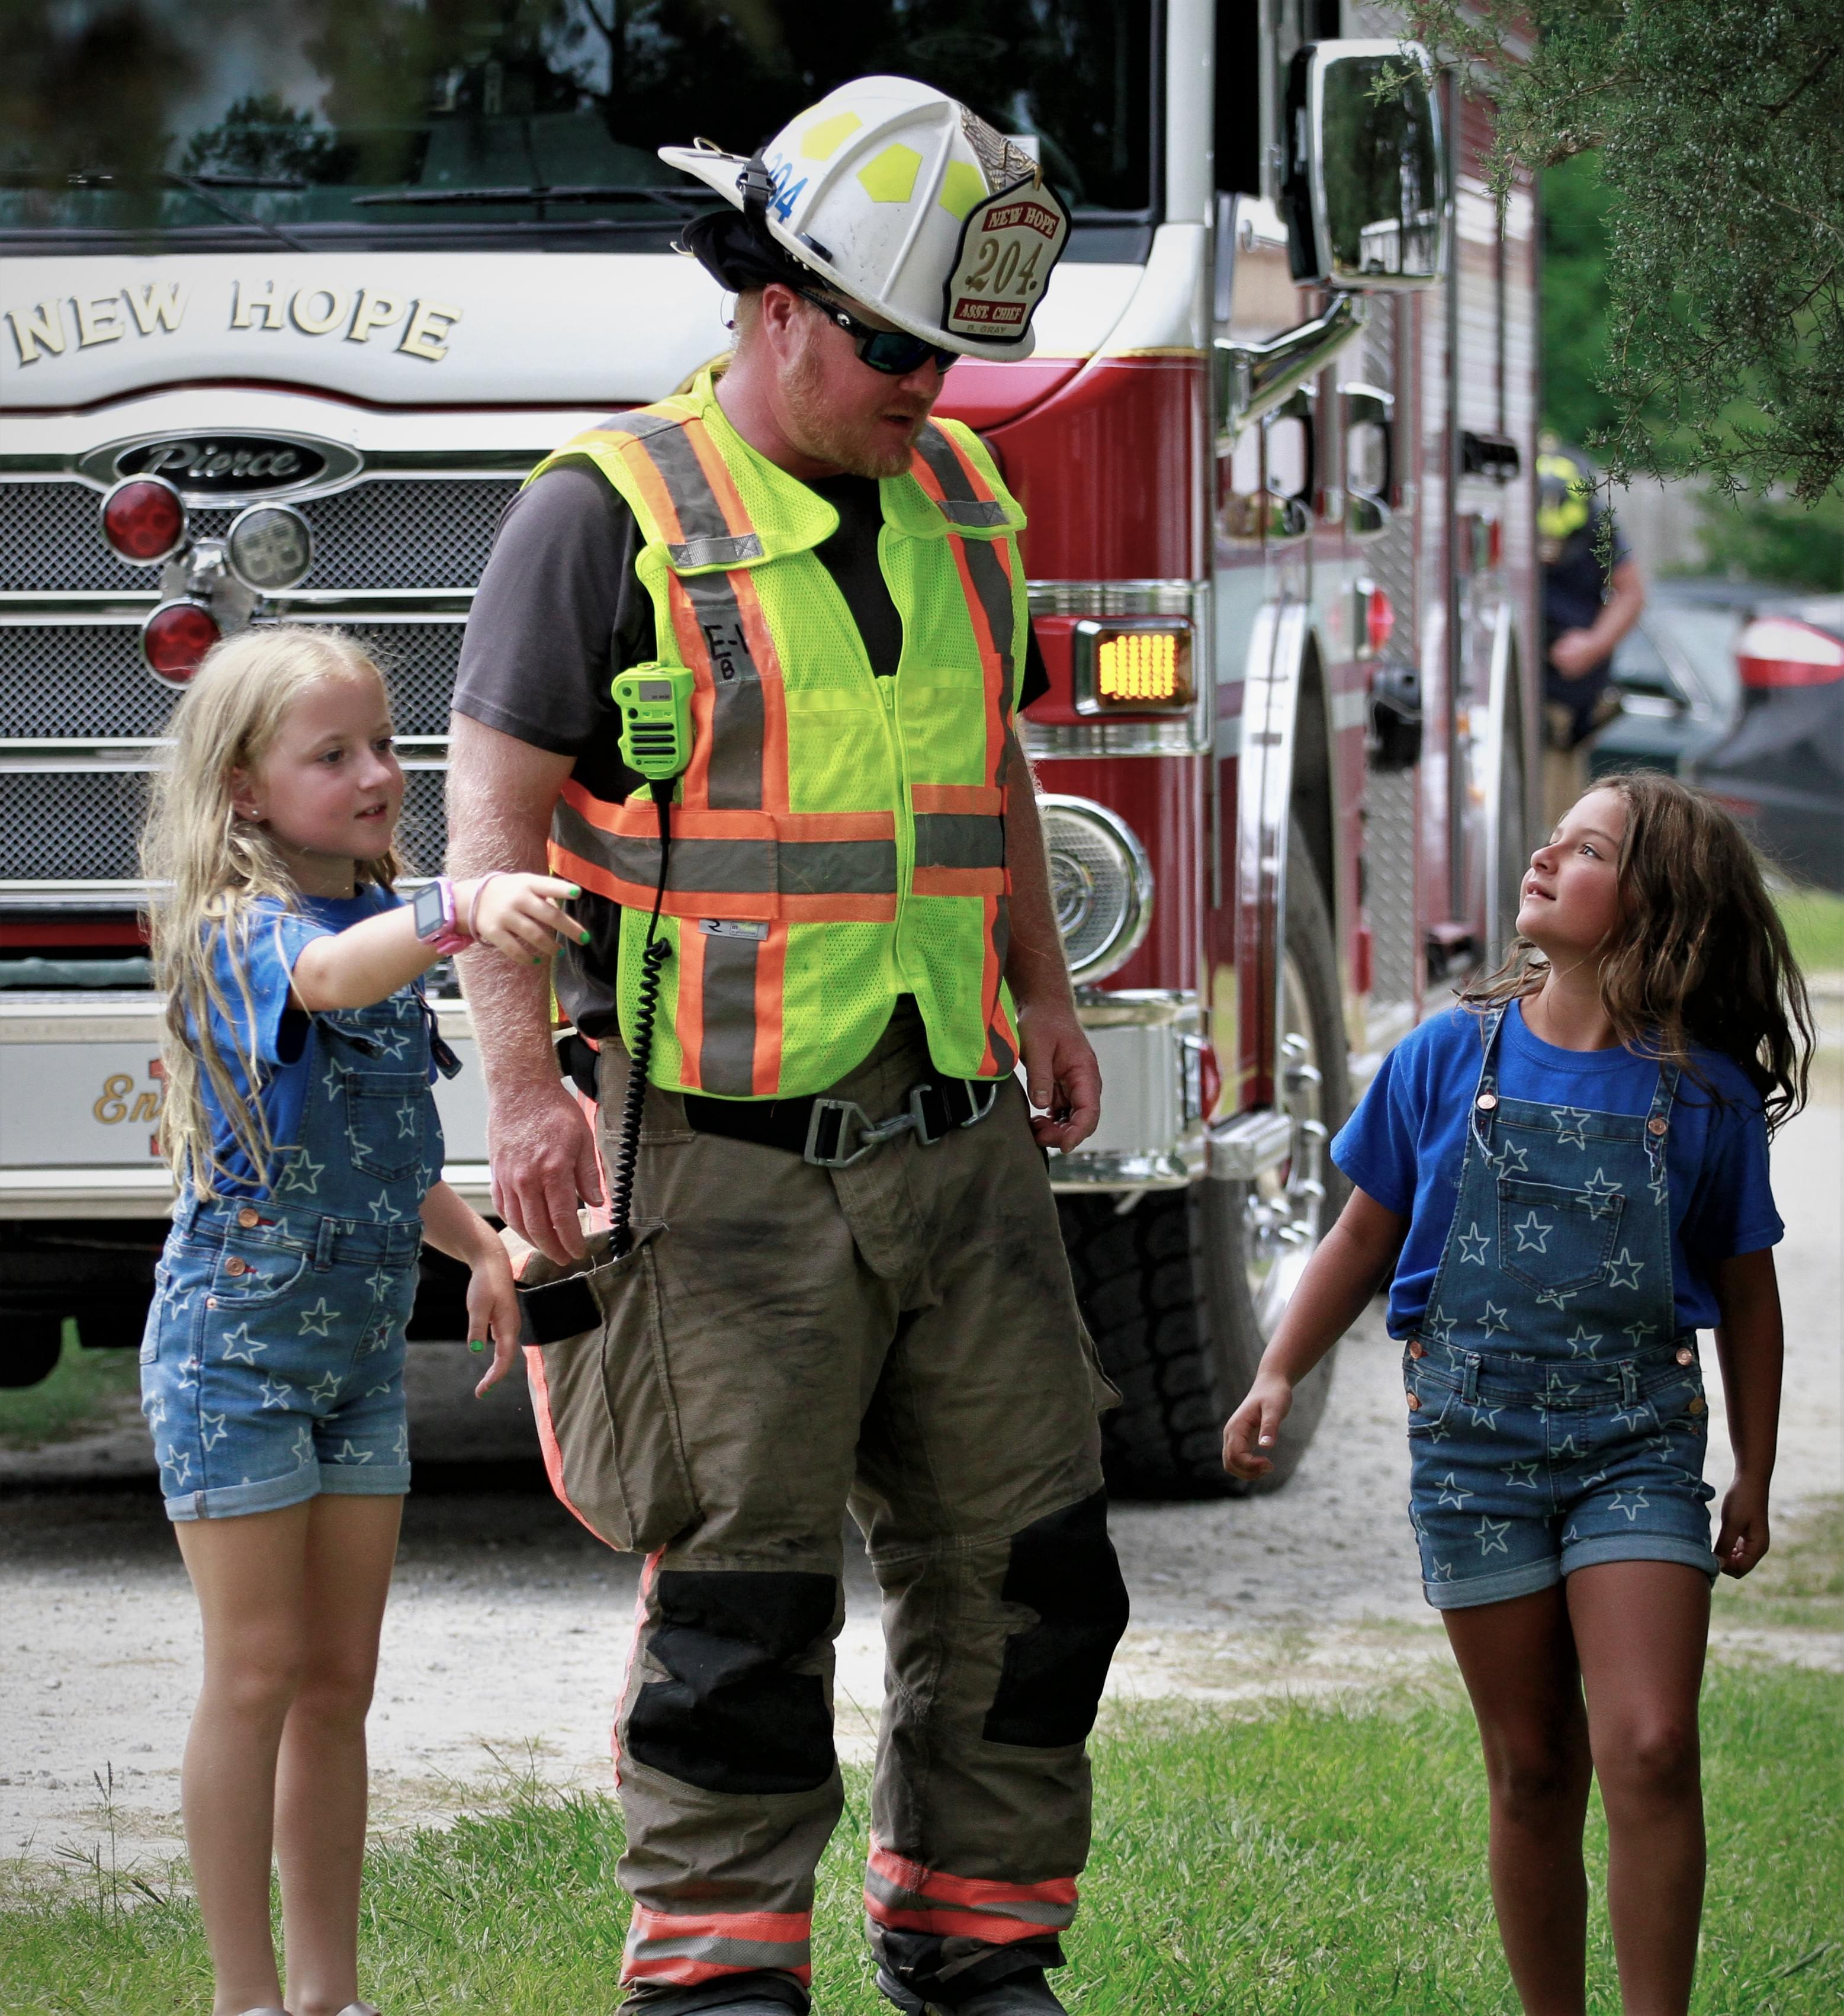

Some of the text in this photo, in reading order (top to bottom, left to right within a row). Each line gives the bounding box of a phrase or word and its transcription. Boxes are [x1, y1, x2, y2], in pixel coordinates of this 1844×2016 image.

[988, 207, 1056, 236] NEW HOPE
[966, 238, 1043, 295] 204
[5, 280, 464, 367] NEW HOPE
[992, 306, 1022, 321] CHIEF
[146, 443, 303, 479] Pierce
[703, 623, 750, 660] E-1
[93, 1074, 163, 1123] En
